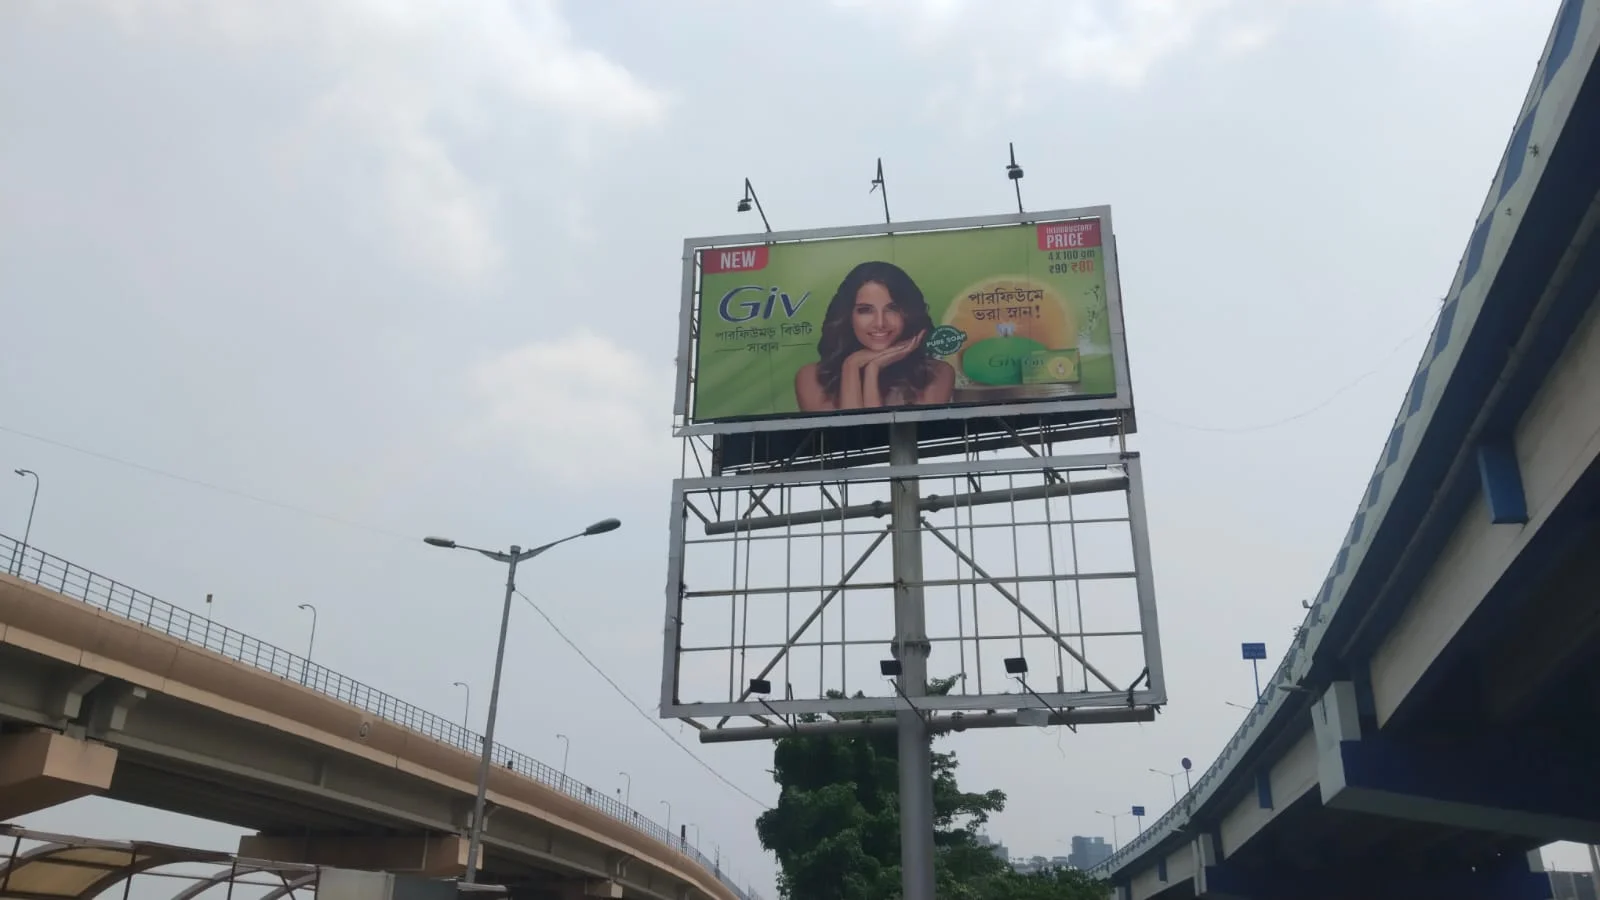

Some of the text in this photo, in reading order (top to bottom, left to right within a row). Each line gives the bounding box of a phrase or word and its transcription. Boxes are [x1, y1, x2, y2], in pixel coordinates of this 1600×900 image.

[1046, 232, 1084, 249] PRICE
[720, 250, 756, 269] NEW
[1048, 251, 1054, 260] 4
[1063, 249, 1079, 259] 100
[1080, 248, 1095, 260] gm
[718, 284, 811, 323] Giv
[968, 287, 1044, 305] পারফিউমে
[972, 308, 1000, 321] ভরা
